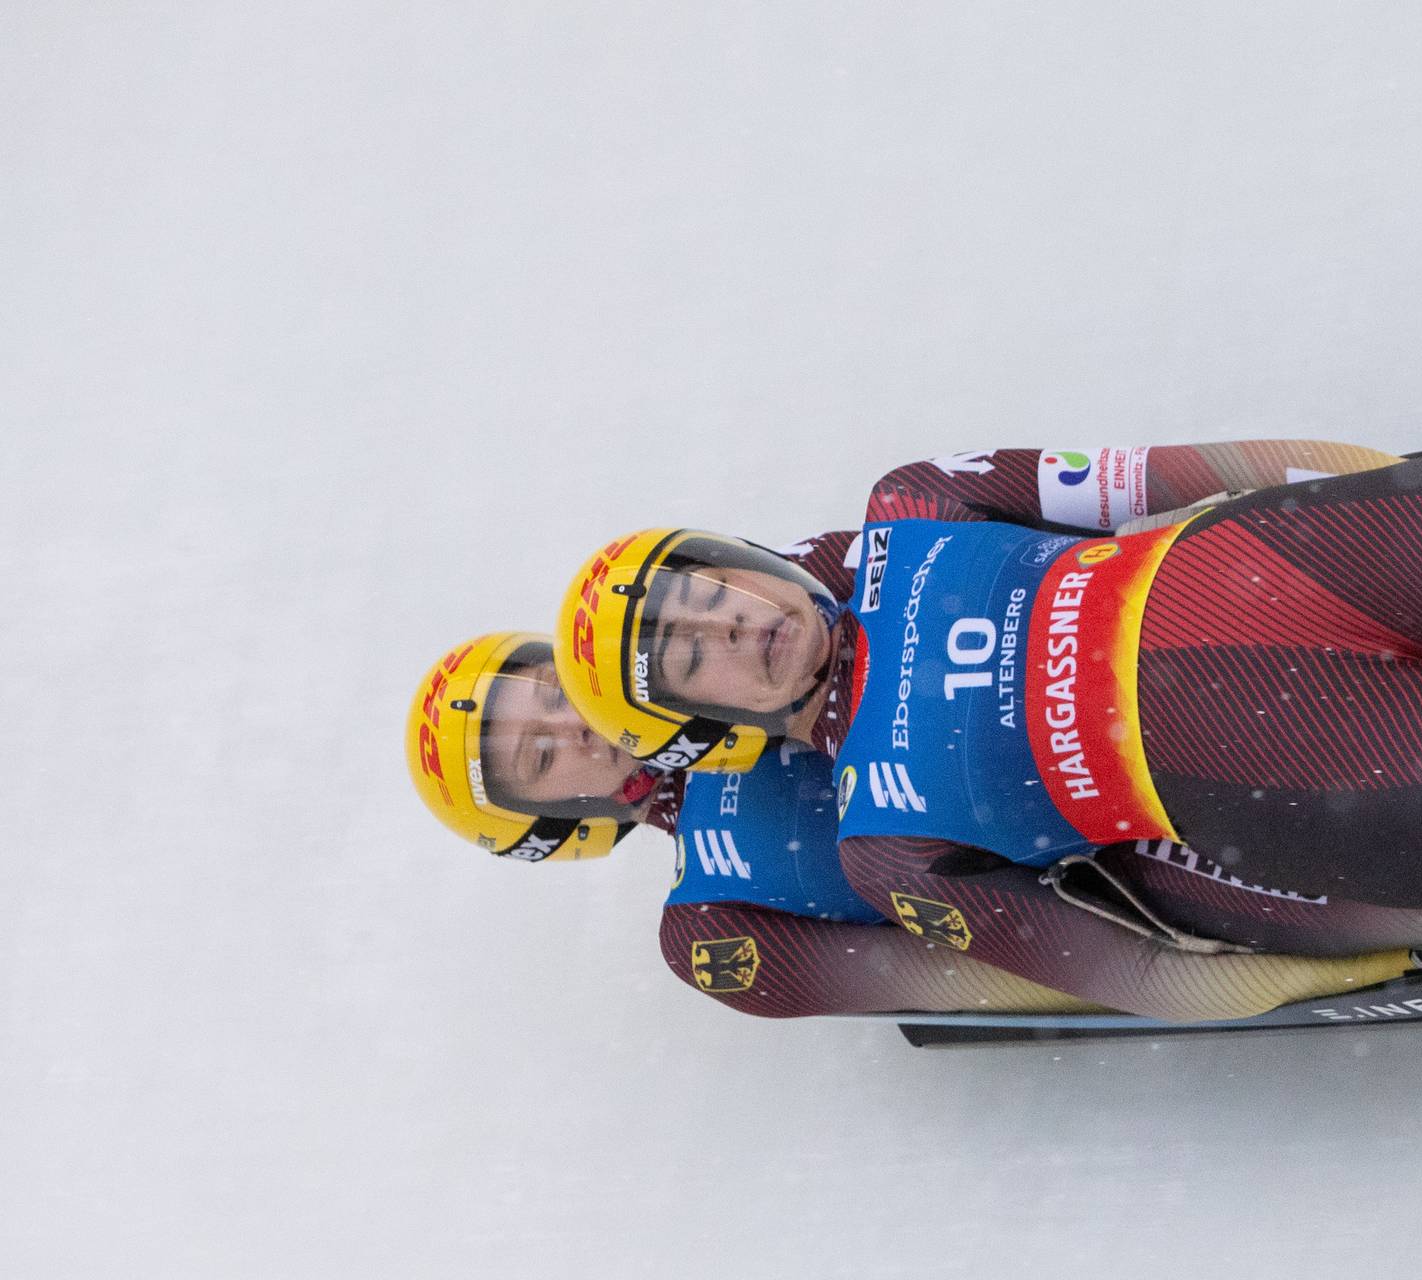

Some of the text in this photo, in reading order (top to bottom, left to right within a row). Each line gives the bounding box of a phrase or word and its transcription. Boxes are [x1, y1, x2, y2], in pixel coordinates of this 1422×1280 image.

[573, 534, 638, 669] DHL
[892, 535, 953, 750] Eberspächer
[944, 617, 996, 700] 10
[999, 588, 1026, 728] ALTENBERG
[419, 644, 474, 782] DHL
[635, 652, 650, 702] uvex
[1045, 570, 1099, 799] HARGASSNER
[469, 758, 488, 805] uvex
